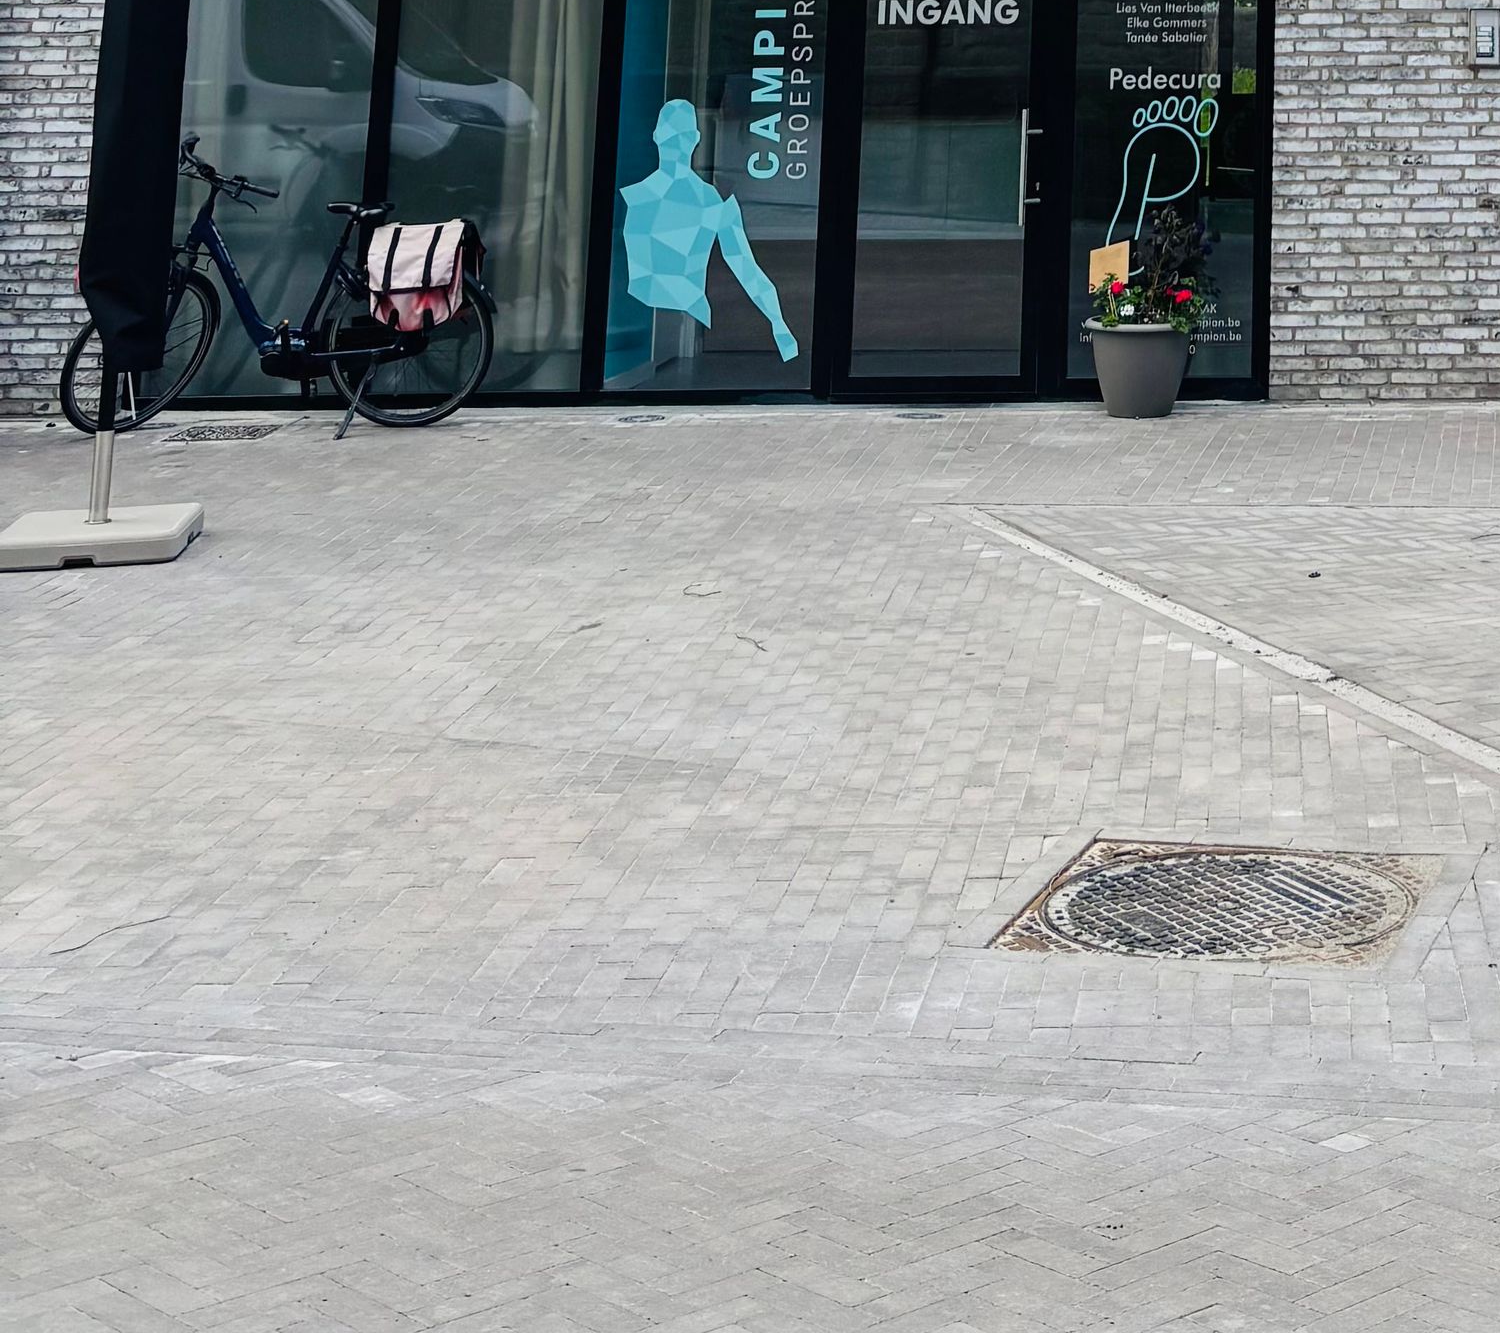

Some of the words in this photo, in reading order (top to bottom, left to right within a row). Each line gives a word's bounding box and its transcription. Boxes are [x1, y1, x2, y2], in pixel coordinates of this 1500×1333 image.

[1116, 2, 1137, 14] Lies
[1140, 2, 1161, 13] Van
[1127, 16, 1149, 28] Elke
[1153, 17, 1207, 28] Gommers
[1161, 31, 1208, 43] Sabatier
[1109, 66, 1221, 91] Pedecura
